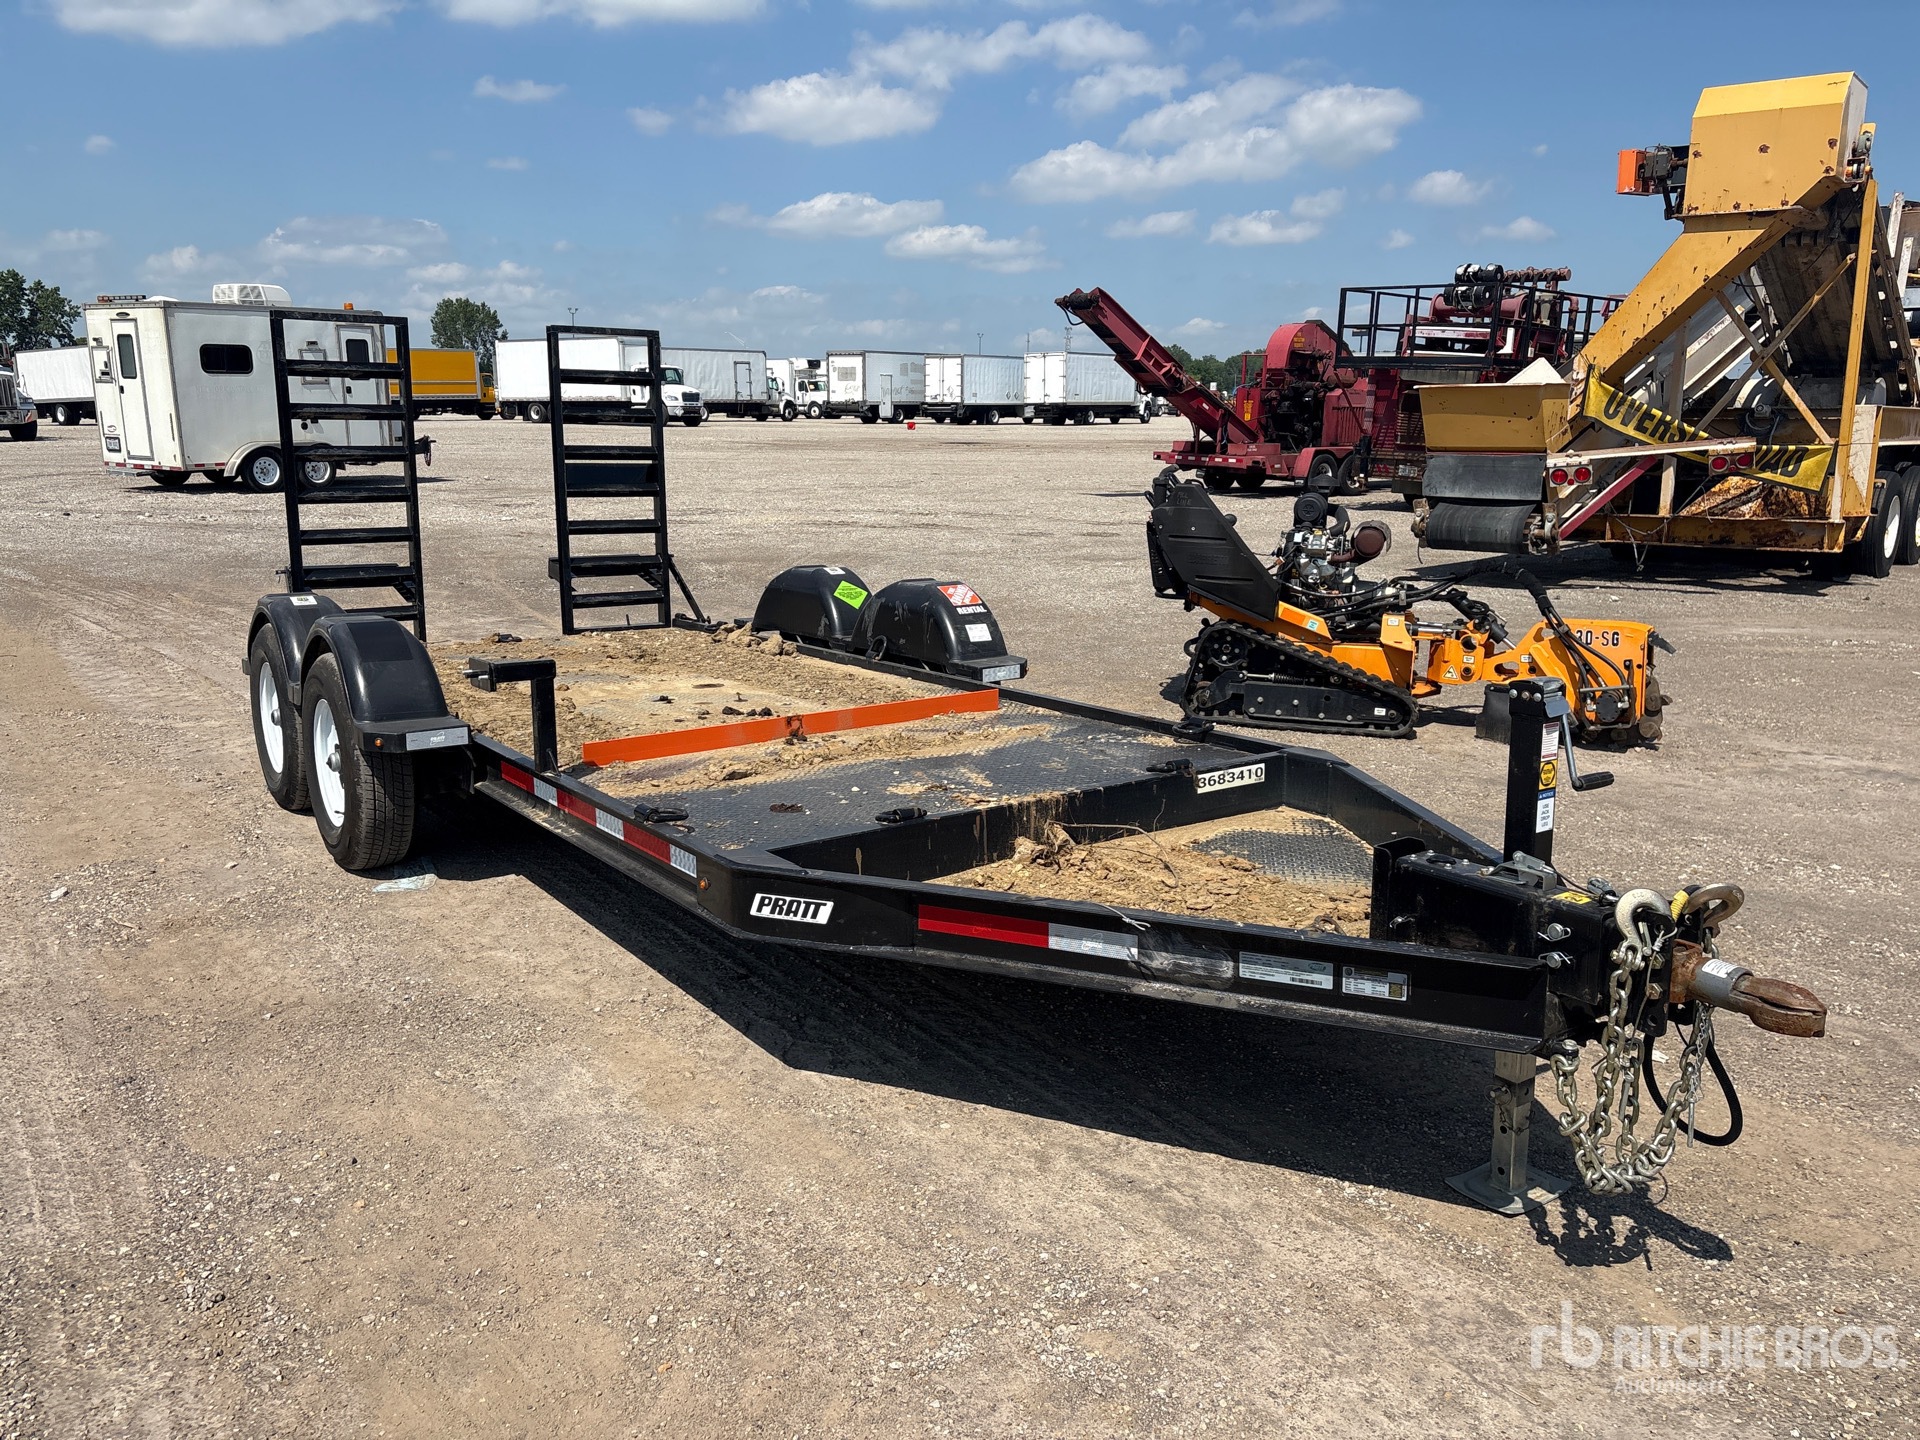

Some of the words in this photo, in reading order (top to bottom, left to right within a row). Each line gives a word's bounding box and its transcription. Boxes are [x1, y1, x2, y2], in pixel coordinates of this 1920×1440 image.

[1603, 389, 1706, 443] OVERSI
[1756, 445, 1810, 477] AD
[956, 605, 988, 615] RENTAL
[1198, 766, 1264, 789] 3683410
[756, 895, 828, 920] PRATT
